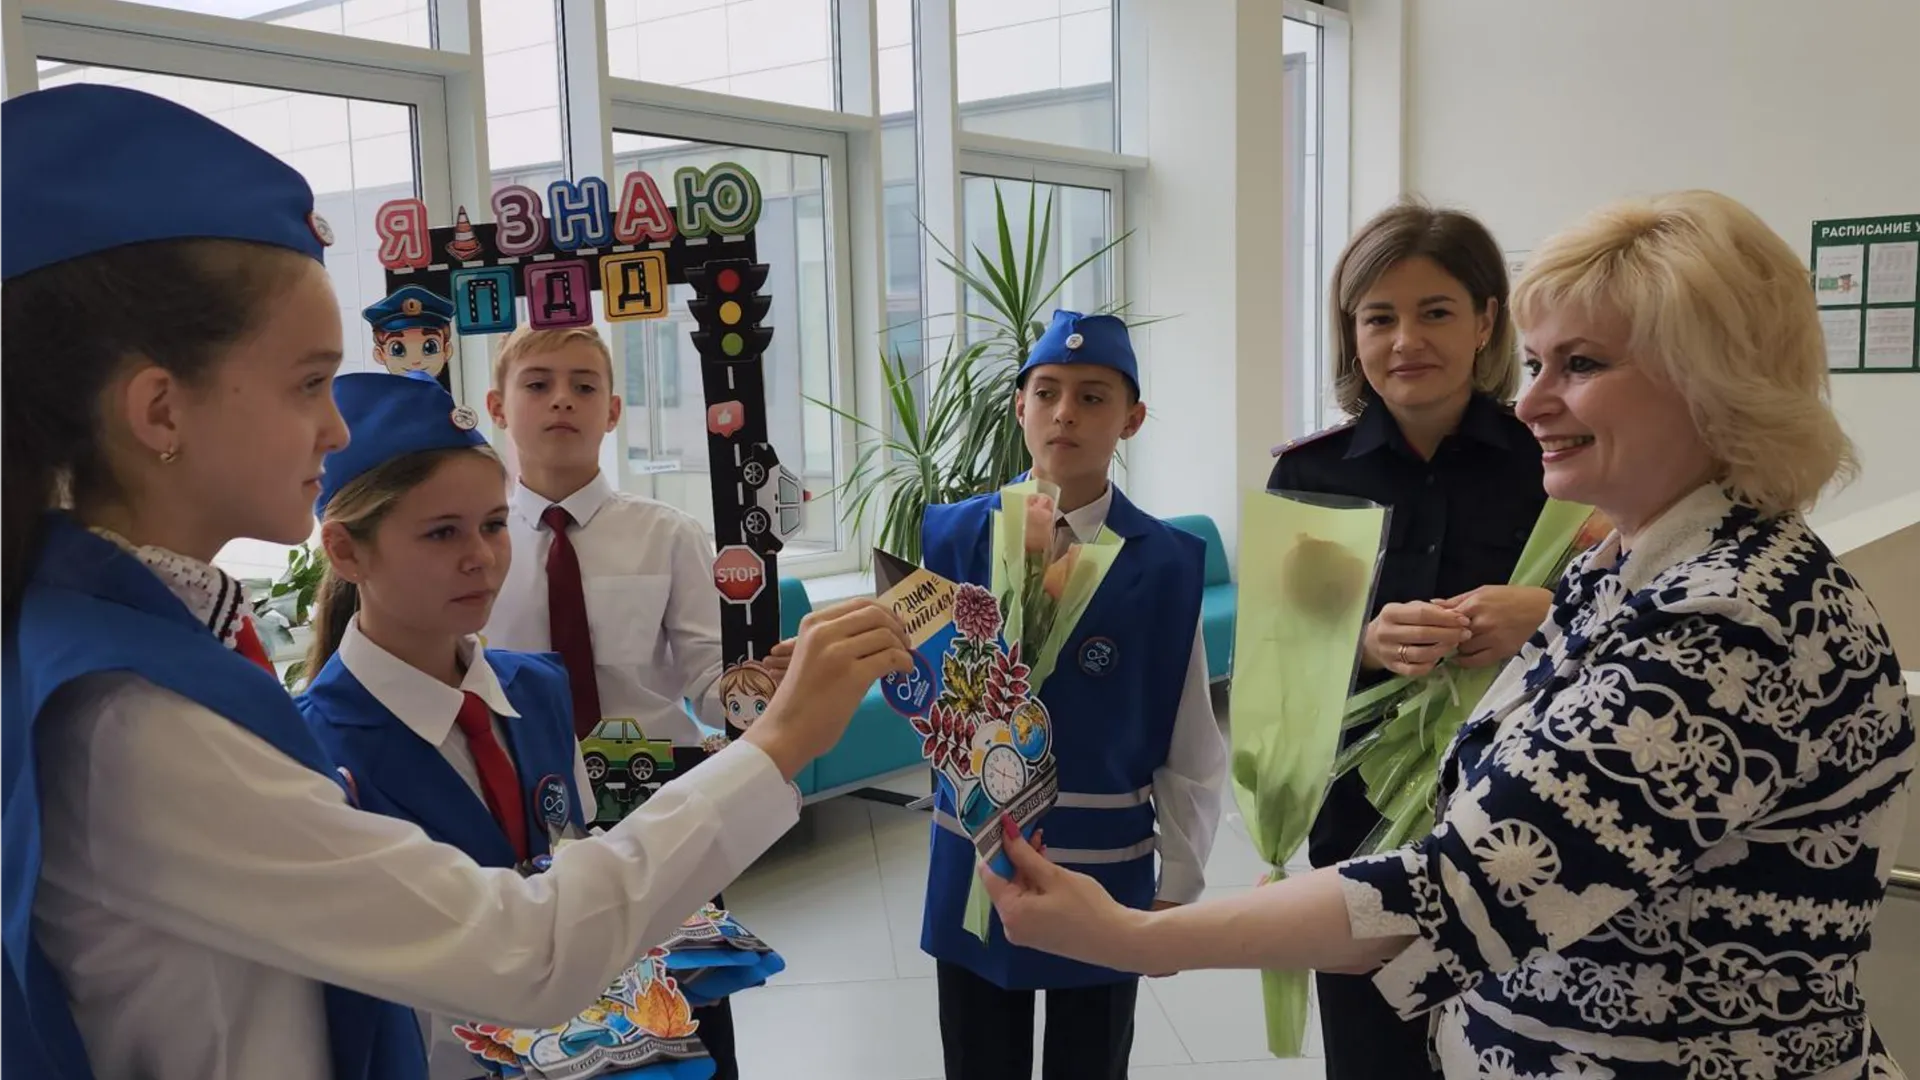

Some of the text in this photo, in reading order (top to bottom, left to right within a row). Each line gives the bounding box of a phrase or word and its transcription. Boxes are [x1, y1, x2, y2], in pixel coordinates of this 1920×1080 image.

[376, 162, 761, 269] Я ЗНАЮ
[1821, 222, 1911, 238] РАСПИСАНИЕ
[466, 262, 650, 323] ПДД
[717, 567, 760, 583] STOP
